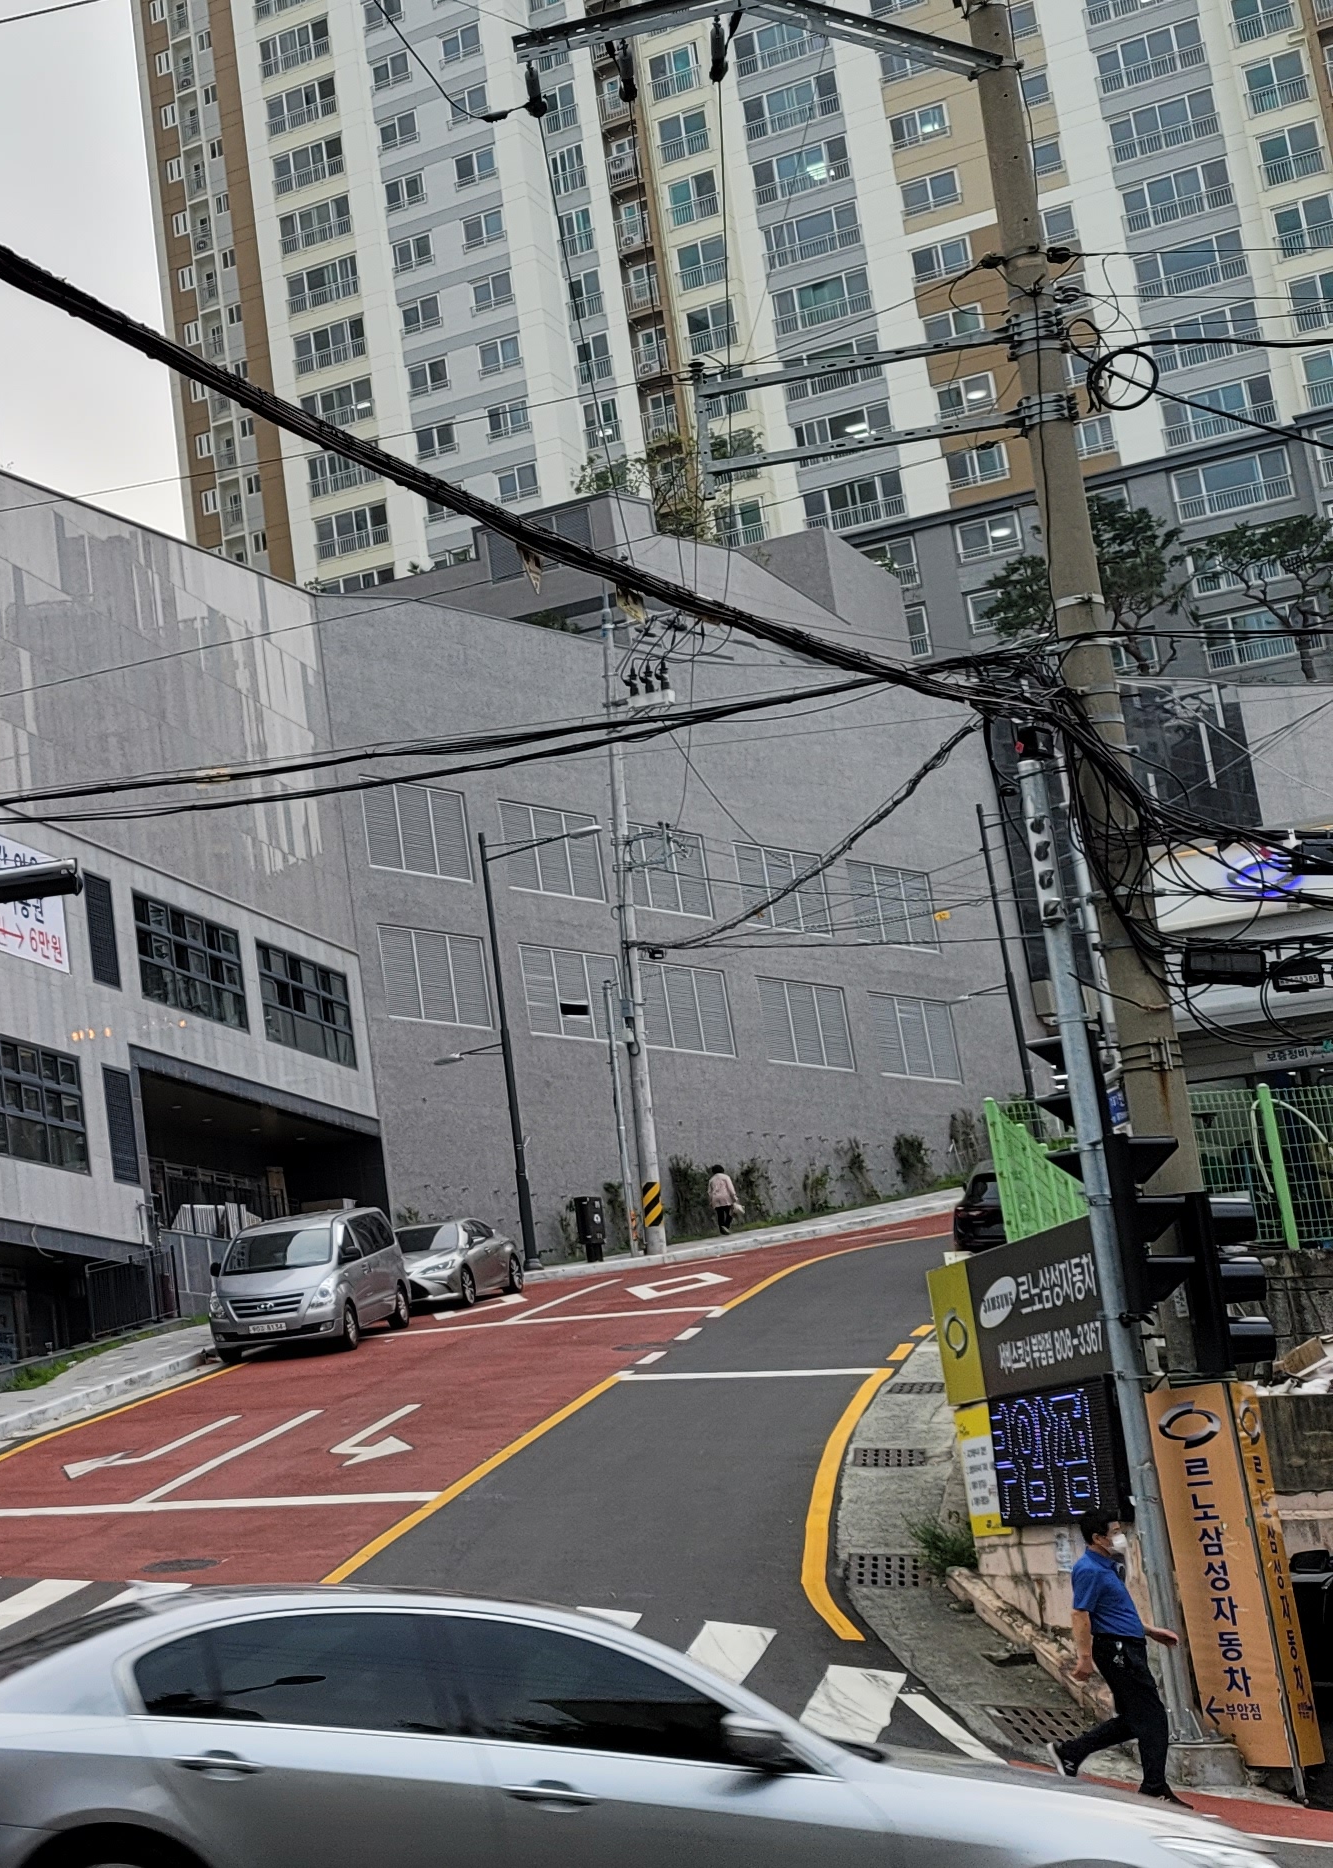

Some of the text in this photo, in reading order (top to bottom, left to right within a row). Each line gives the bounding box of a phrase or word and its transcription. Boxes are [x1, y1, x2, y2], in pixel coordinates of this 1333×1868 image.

[29, 927, 64, 965] 6만원
[983, 1289, 1015, 1315] SAMSUNG
[1017, 1252, 1097, 1315] 르노삼성자동차
[1054, 1320, 1103, 1362] 808-3367
[1184, 1457, 1252, 1699] 르노삼성자동차
[1224, 1701, 1263, 1722] 부암점
